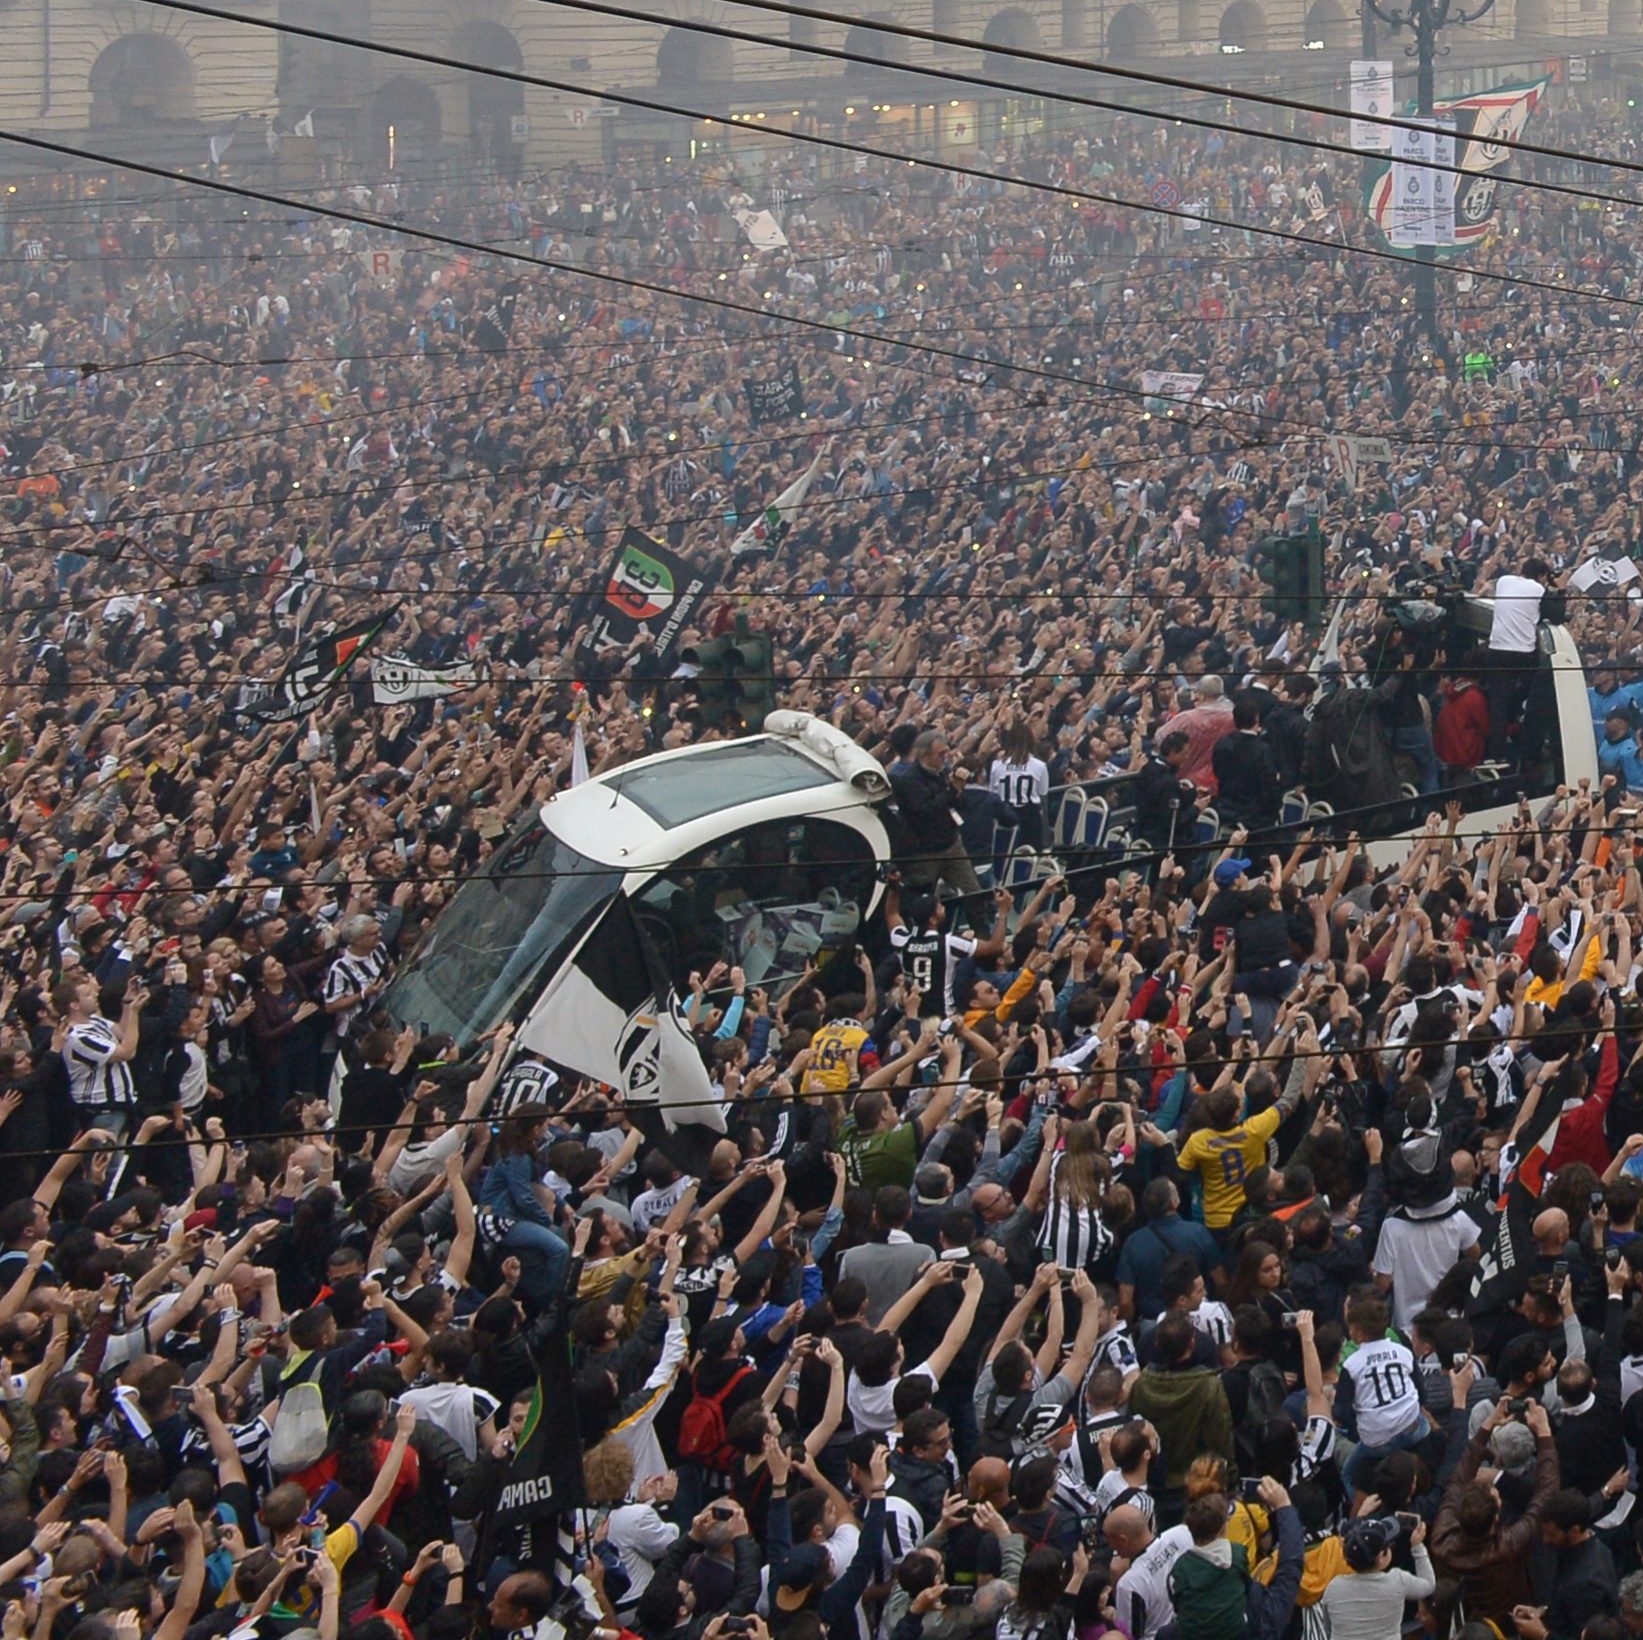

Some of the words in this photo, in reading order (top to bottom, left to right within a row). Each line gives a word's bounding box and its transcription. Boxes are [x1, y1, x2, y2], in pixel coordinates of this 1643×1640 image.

[373, 252, 390, 275] R
[1000, 774, 1033, 808] 10
[913, 956, 932, 992] 9
[1220, 1148, 1247, 1187] 8
[1364, 1362, 1408, 1409] 10
